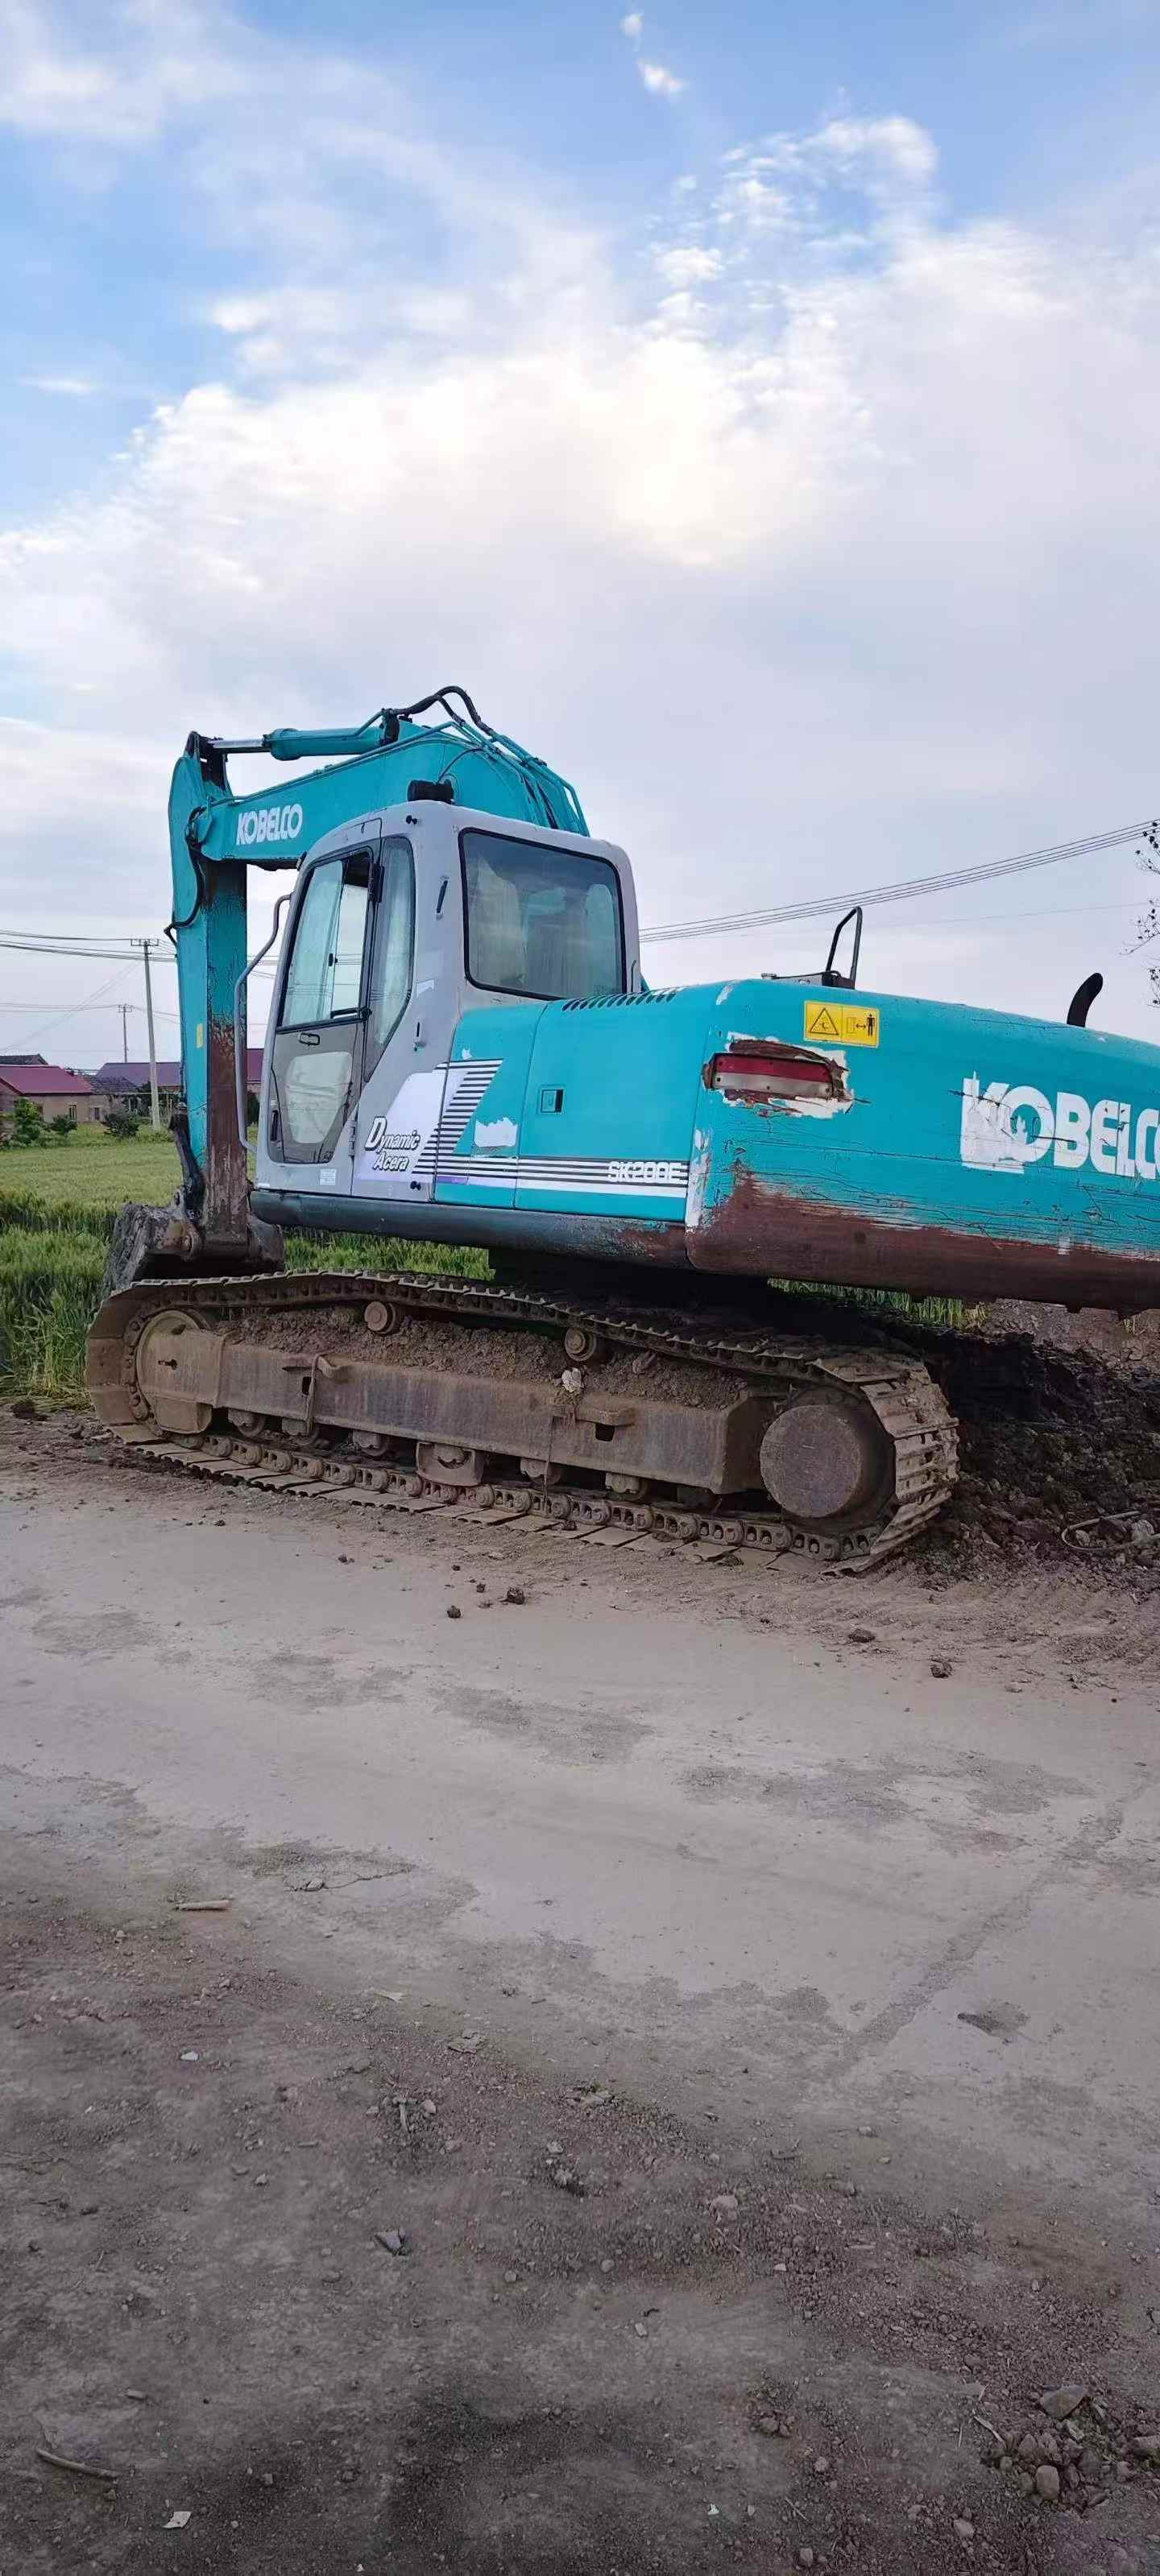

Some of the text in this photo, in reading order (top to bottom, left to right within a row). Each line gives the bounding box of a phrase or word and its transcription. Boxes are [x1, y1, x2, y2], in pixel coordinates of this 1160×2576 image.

[236, 804, 303, 846] KOBELCO
[364, 1116, 420, 1154] Dynamic
[960, 1071, 1160, 1180] KOBELC
[372, 1151, 410, 1172] Acera
[607, 1161, 689, 1185] SK200E
